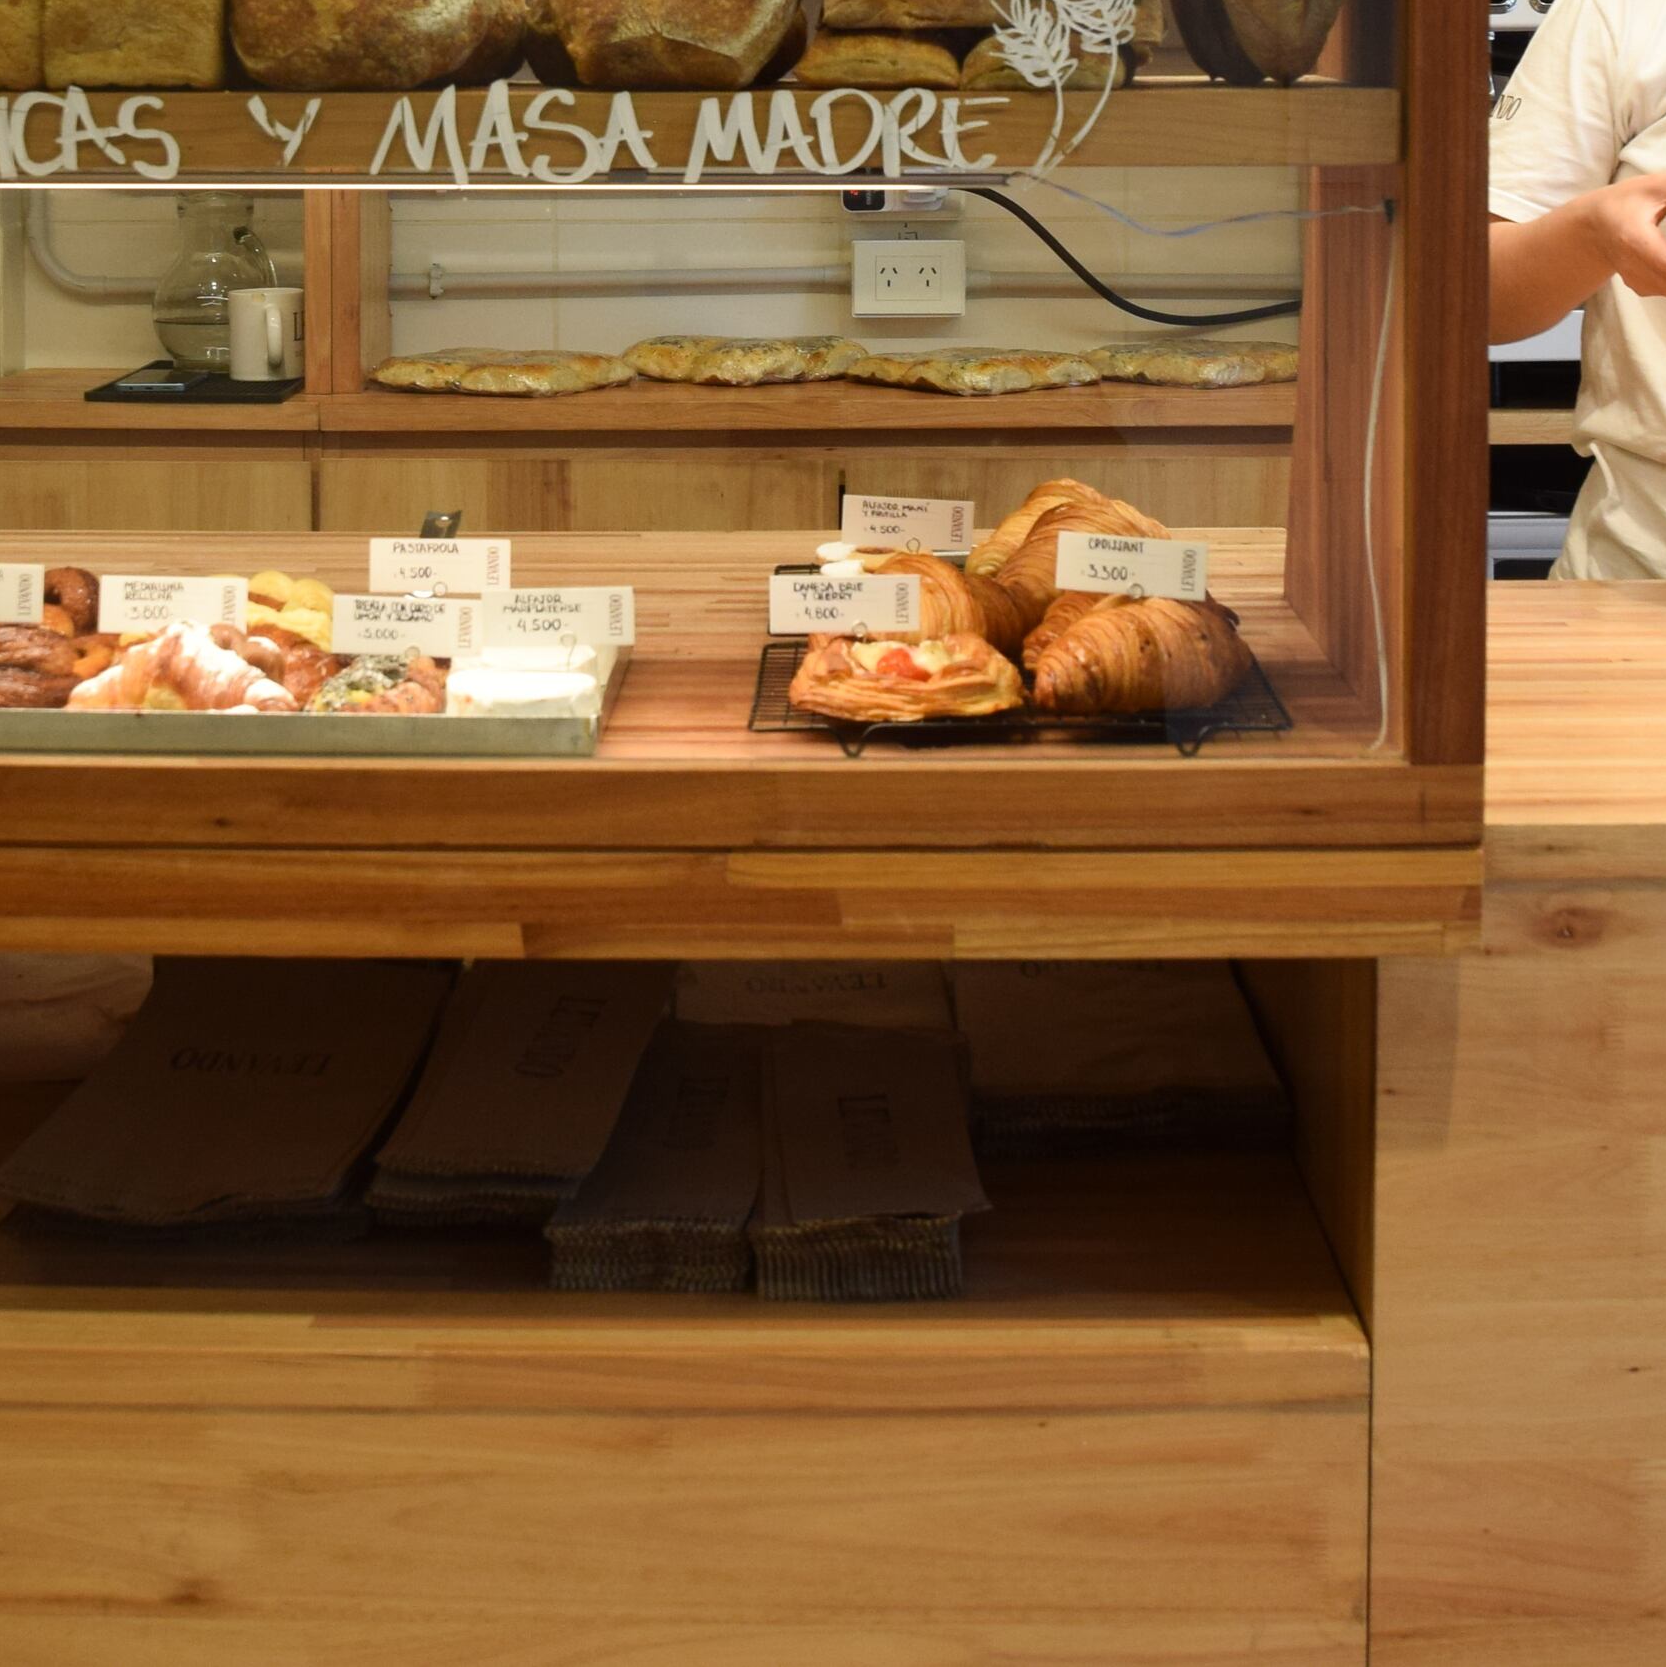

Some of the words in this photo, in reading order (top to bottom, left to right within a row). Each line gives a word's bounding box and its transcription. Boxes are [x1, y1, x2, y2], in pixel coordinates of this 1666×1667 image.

[246, 94, 322, 167] Y
[368, 79, 659, 186] MASA
[683, 86, 1011, 185] MADRE
[950, 505, 965, 543] LEVANDO
[392, 541, 459, 554] PASTAFROLA
[486, 545, 500, 585] LEVANDO
[1088, 537, 1145, 554] CROISSANT
[1181, 548, 1197, 592] LEVANDO
[17, 573, 32, 616] LEVANDO
[514, 593, 562, 604] ALFAJOR
[608, 593, 624, 636] LEVANDO
[895, 582, 910, 624] LEVANDO
[458, 606, 472, 649] LEVANDO
